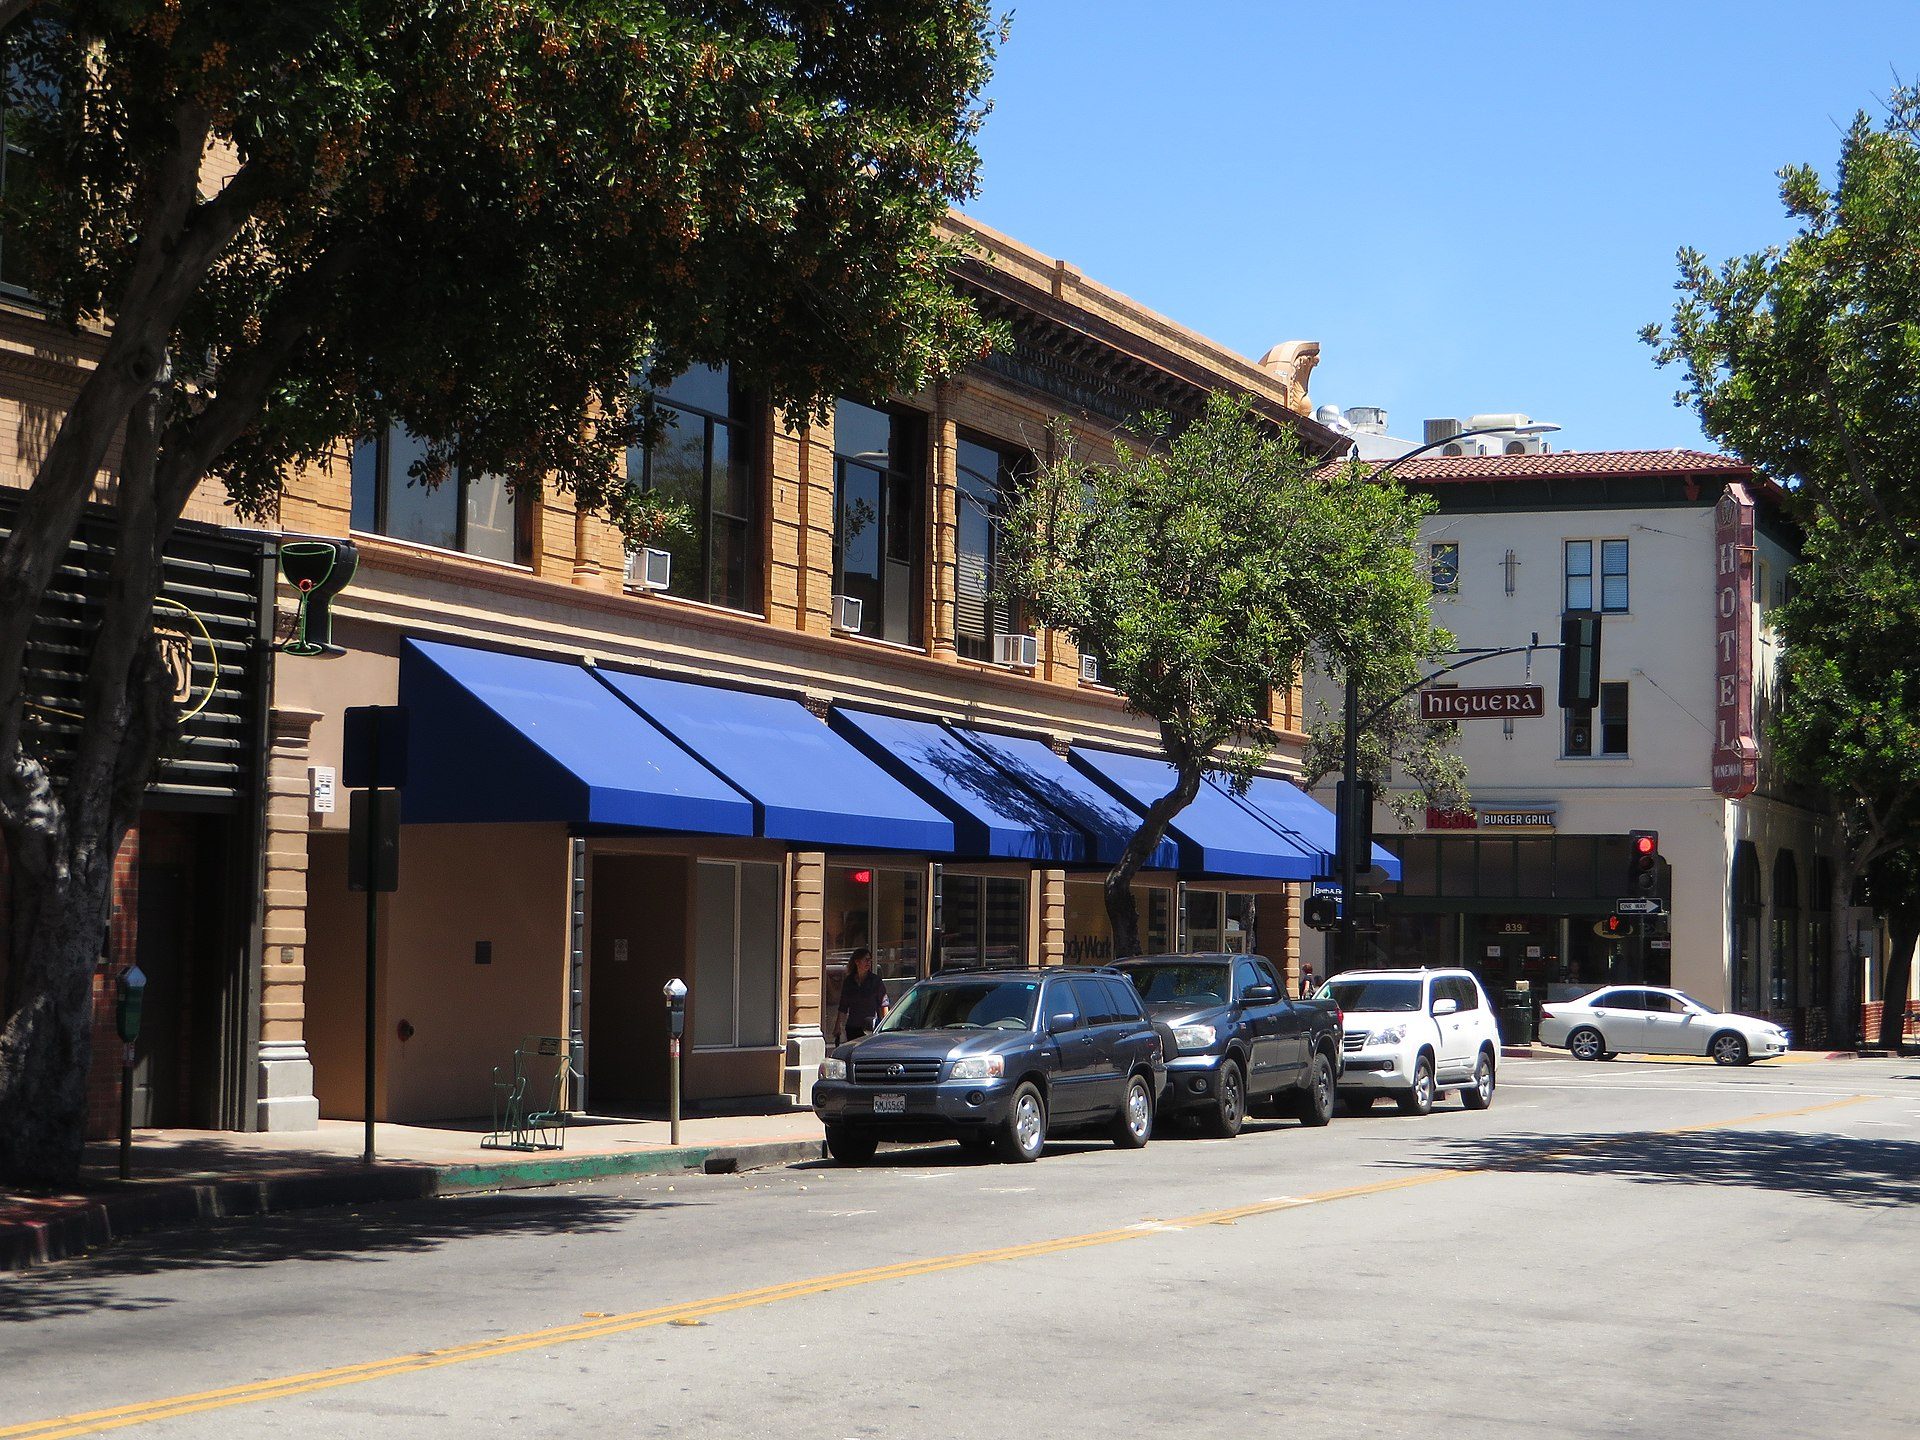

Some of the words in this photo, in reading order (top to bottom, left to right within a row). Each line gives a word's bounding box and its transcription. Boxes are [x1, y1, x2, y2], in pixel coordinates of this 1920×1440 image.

[1719, 541, 1736, 751] HOTEL
[1428, 694, 1536, 715] HIGUERA
[1484, 814, 1522, 825] BURGER
[1525, 814, 1552, 825] GRILL
[1505, 923, 1523, 932] 839
